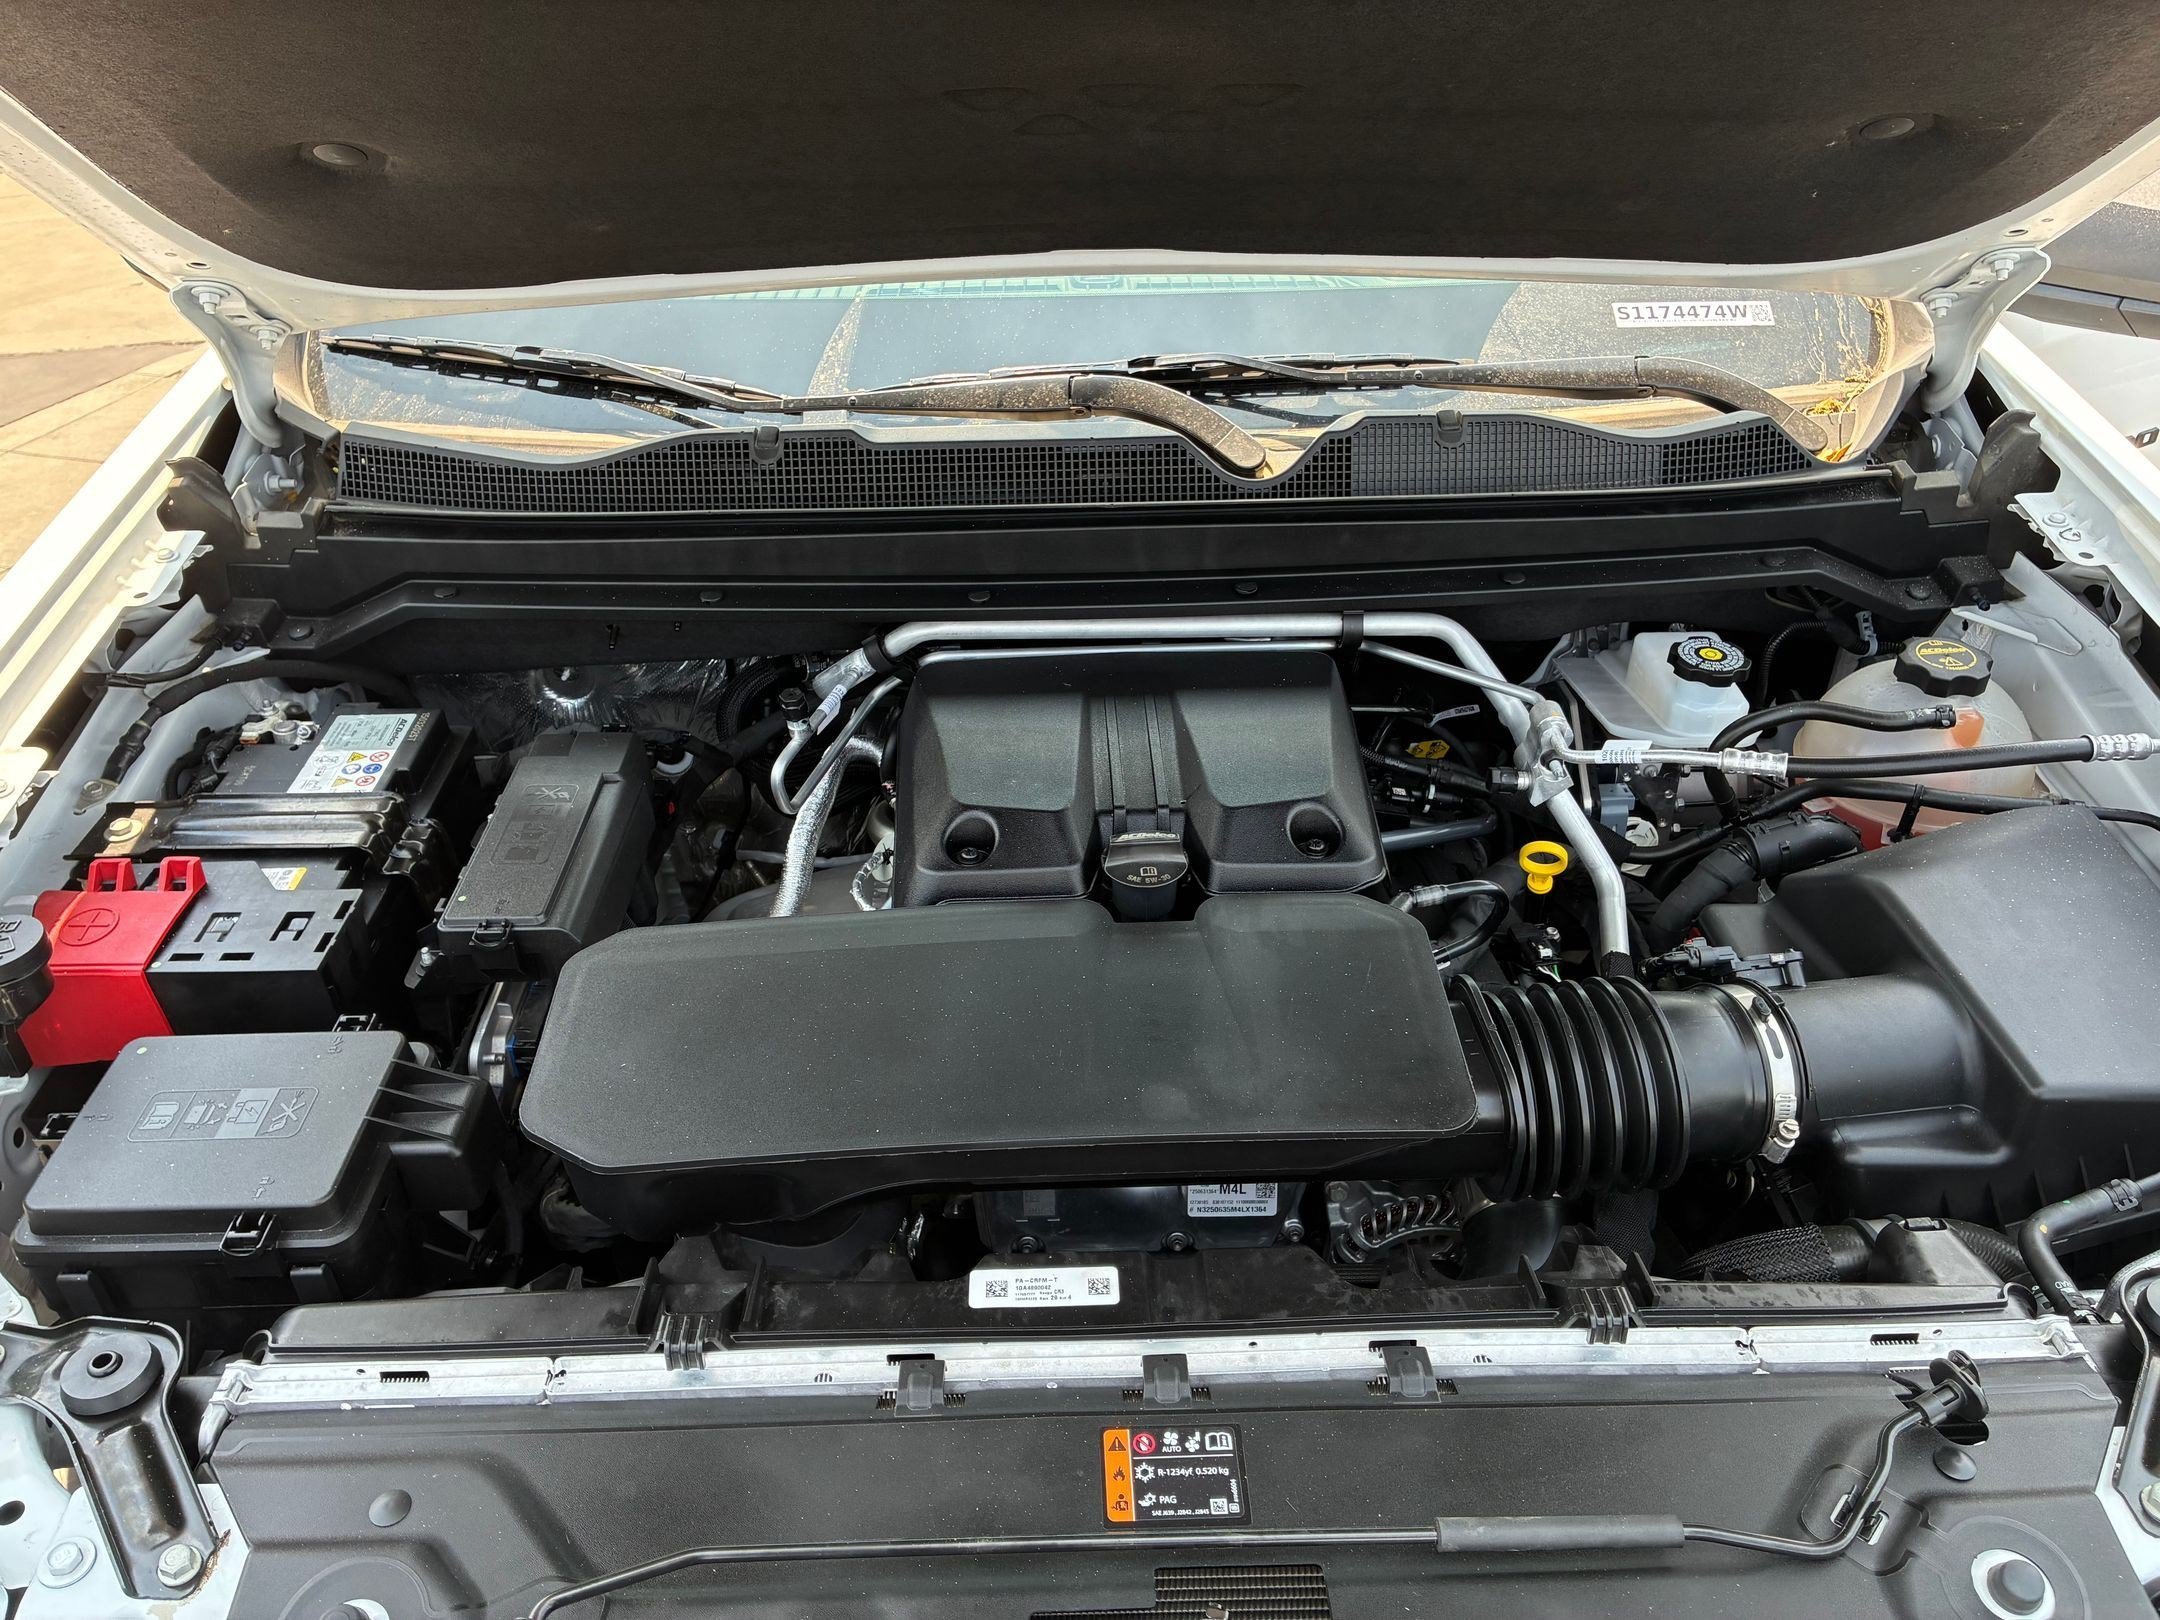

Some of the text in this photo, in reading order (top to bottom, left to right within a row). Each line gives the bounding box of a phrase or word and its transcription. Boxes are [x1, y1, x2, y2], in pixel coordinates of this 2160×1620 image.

[1617, 305, 1747, 320] S1174474W
[387, 718, 408, 747] ACDelco
[1116, 832, 1177, 841] ACDelco
[1126, 873, 1171, 884] SAE 5W-30
[1219, 1184, 1247, 1195] M4L
[1162, 1445, 1182, 1453] AUTO
[1157, 1466, 1230, 1477] R-1234yf 0.520 kg
[1159, 1495, 1177, 1503] PAG
